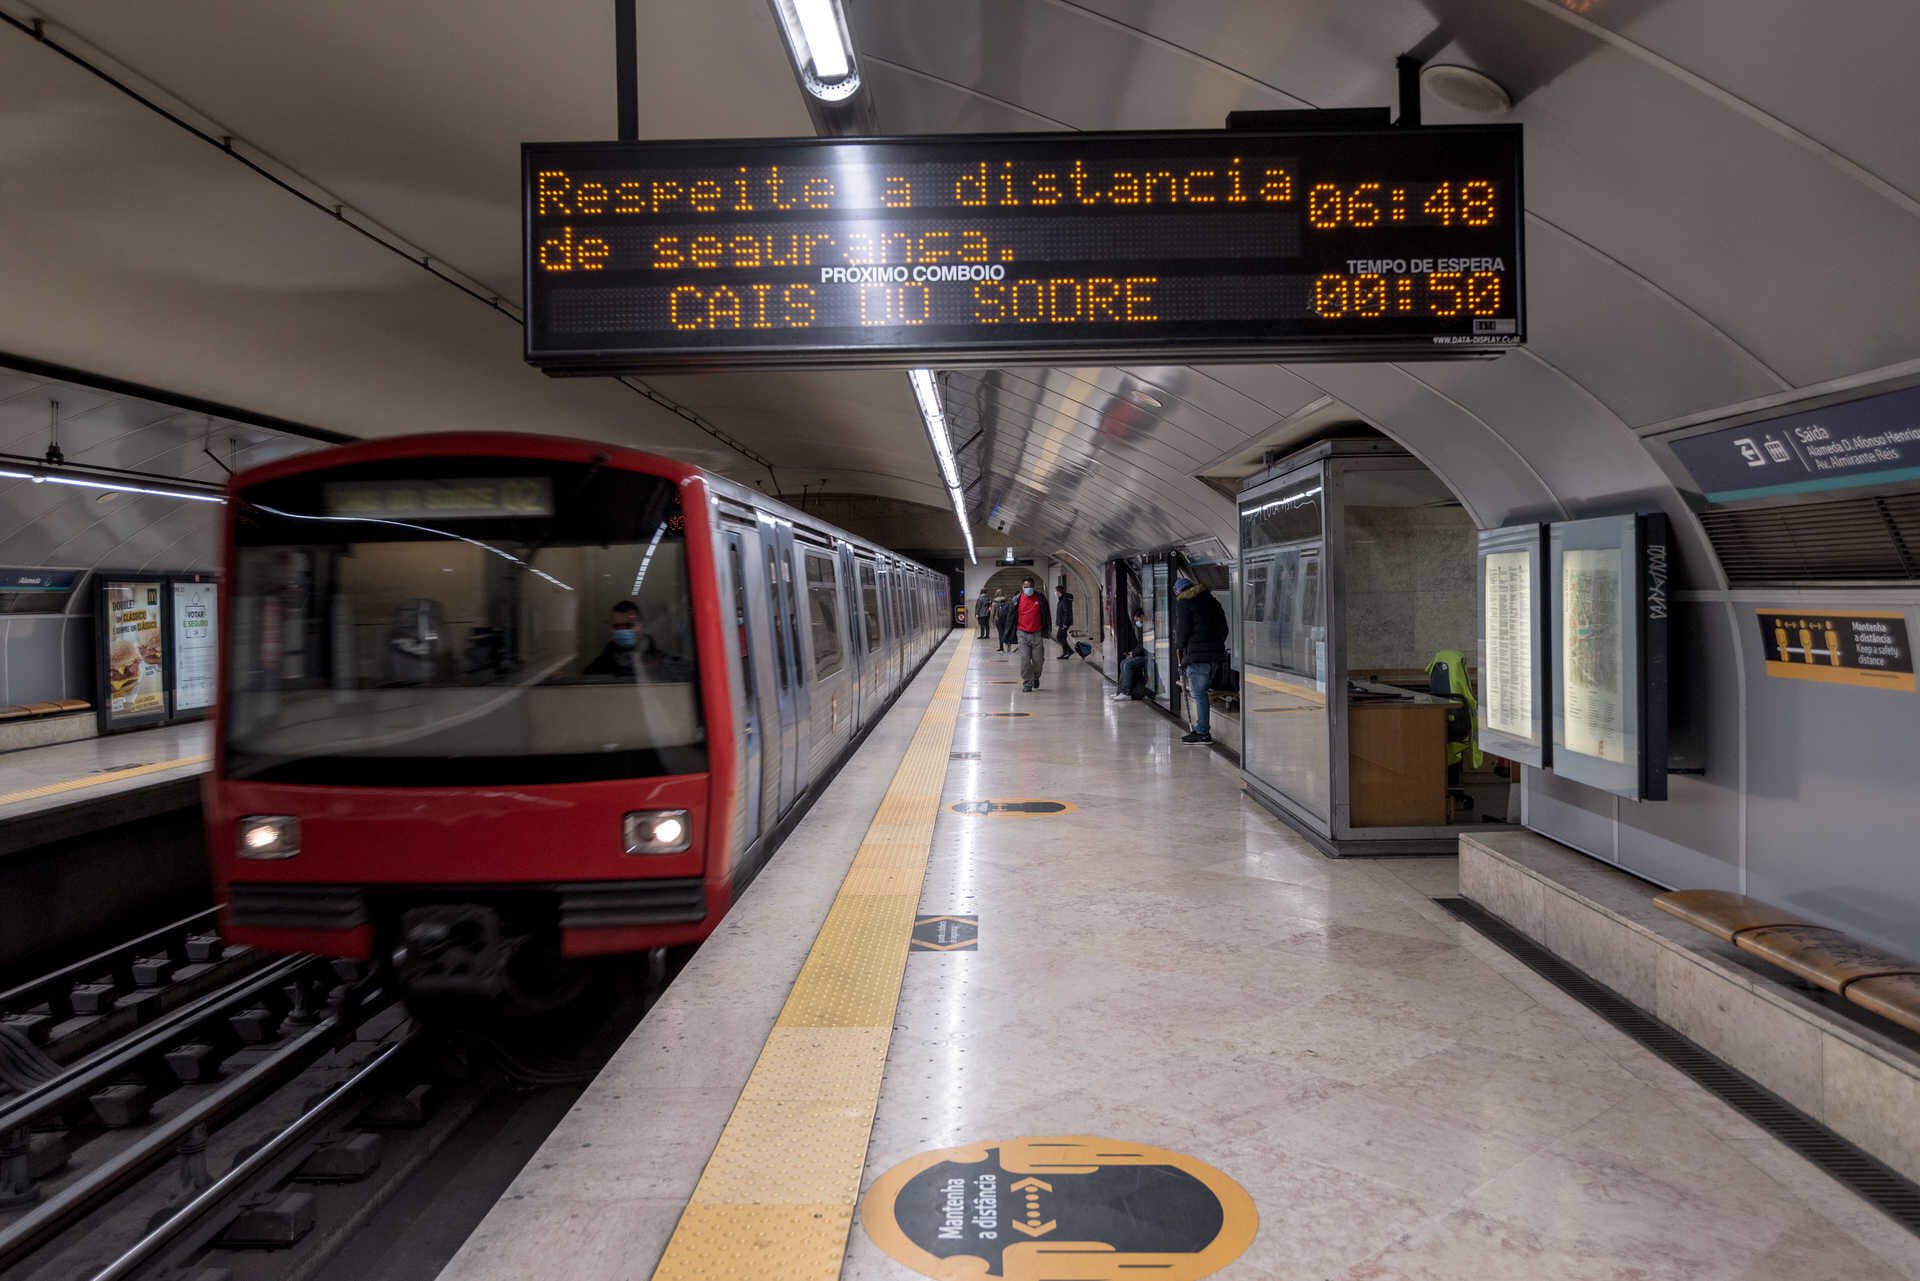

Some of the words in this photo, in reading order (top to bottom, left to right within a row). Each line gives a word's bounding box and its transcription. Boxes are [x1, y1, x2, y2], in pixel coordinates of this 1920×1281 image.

[881, 175, 913, 209] a
[954, 157, 1292, 206] distancia
[1308, 180, 1495, 229] 06:48
[539, 225, 611, 271] de
[912, 264, 1006, 282] COMBOIO
[1346, 259, 1407, 275] TEMPO
[1409, 259, 1435, 274] DE
[1437, 257, 1506, 273] ESPERA
[669, 283, 817, 330] CAIS
[859, 280, 931, 327] DO
[973, 276, 1160, 325] SODRE
[1314, 270, 1501, 318] 00:50
[1807, 441, 1843, 457] Alameda
[1851, 436, 1886, 450] Afonso
[1830, 453, 1876, 468] Almirante
[1877, 448, 1899, 461] Reis
[1851, 620, 1887, 633] Mantenha
[1856, 643, 1873, 654] Keep
[1858, 656, 1885, 666] distance
[937, 1177, 966, 1241] Mantenha
[972, 1172, 998, 1229] distância
[980, 1230, 998, 1240] a
